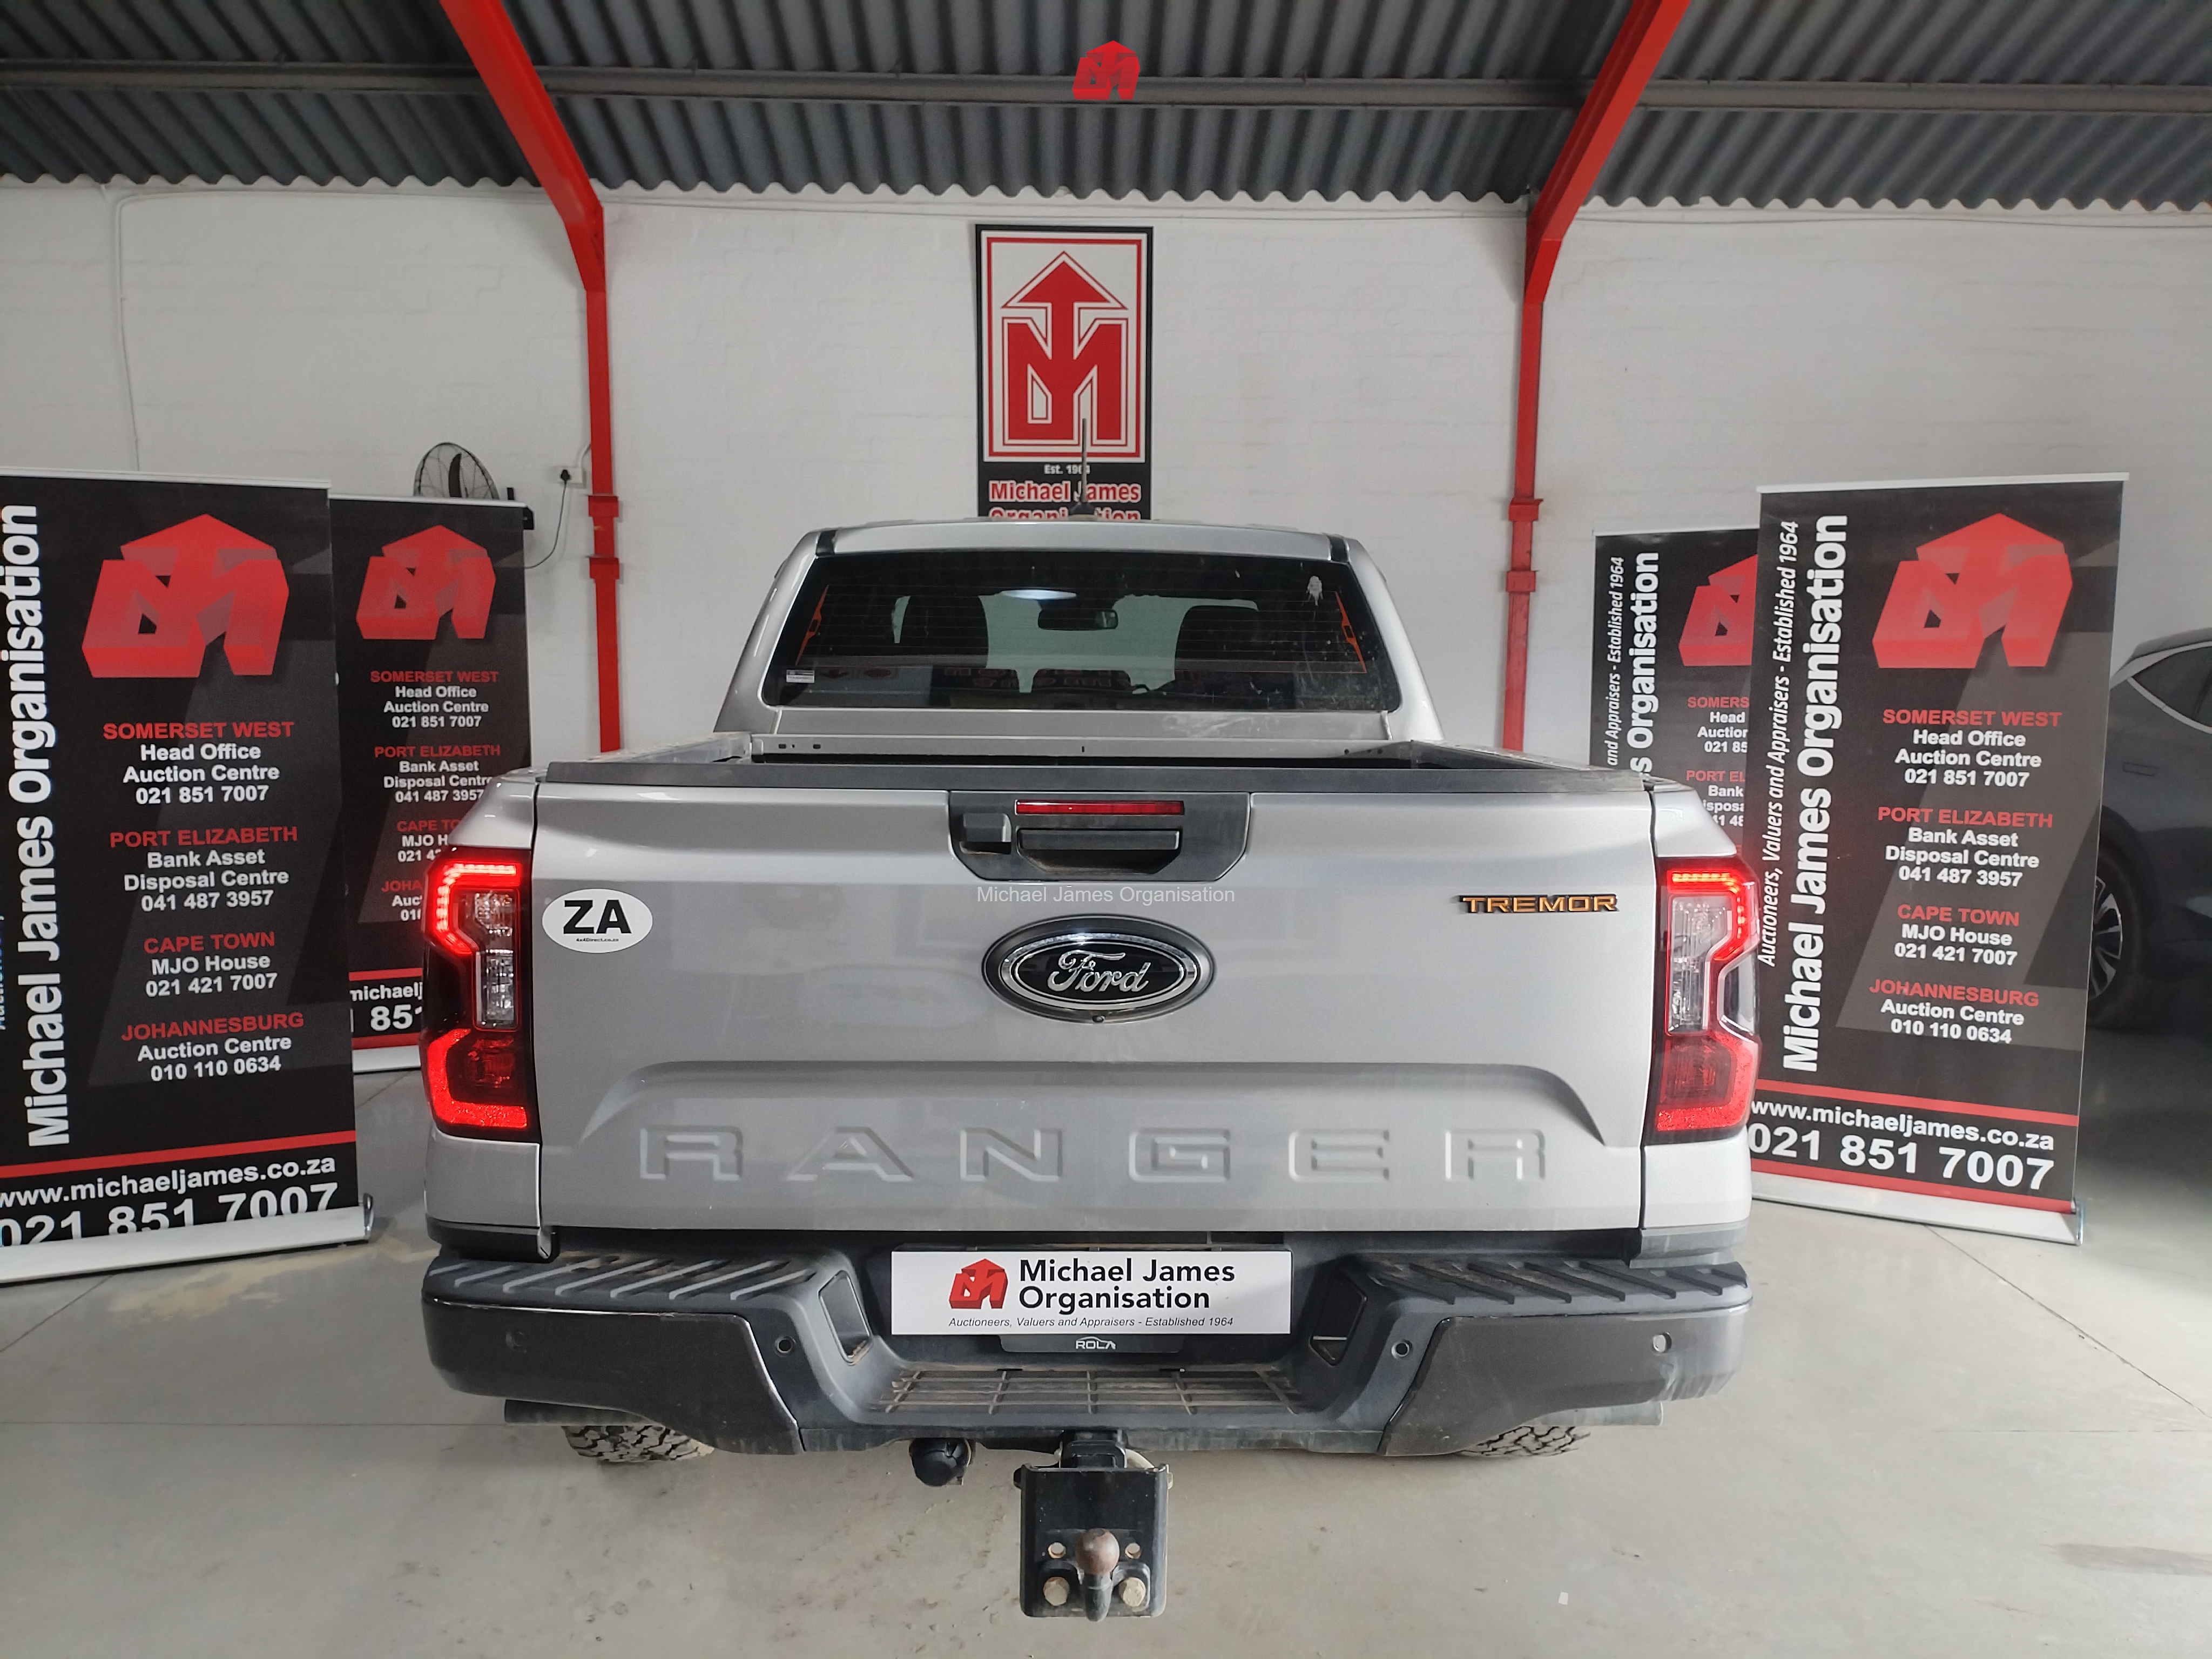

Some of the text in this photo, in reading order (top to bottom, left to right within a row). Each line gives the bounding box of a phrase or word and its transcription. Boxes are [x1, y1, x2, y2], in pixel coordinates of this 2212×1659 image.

[1044, 464, 1063, 474] Est.
[989, 480, 1071, 502] Michael
[1779, 522, 1798, 562] 1964
[1610, 557, 1624, 588] 1964
[1773, 567, 1795, 662] Established
[1607, 591, 1622, 663] Established
[1627, 553, 1658, 748] Organisation
[371, 671, 498, 682] SOMERSET WEST
[395, 686, 476, 697] Head Office
[1688, 696, 1750, 708] SOMERS
[384, 701, 488, 712] Auction Centre
[1604, 673, 1622, 746] Appraisers
[392, 716, 481, 727] 021 851 7007
[1710, 712, 1745, 723] Head
[1768, 676, 1790, 763] Appraisers
[1883, 709, 2061, 726] SOMERSET WEST
[104, 721, 294, 739] SOMERSET WEST
[1913, 729, 2026, 746] Head Office
[141, 743, 261, 760] Head Office
[375, 745, 500, 758] PORT ELIZABETH
[1608, 750, 1617, 765] and
[1704, 741, 1748, 753] 021 85
[1895, 748, 2041, 767] Auction Centre
[123, 765, 280, 783] Auction Centre
[400, 760, 479, 772] Bank Asset
[1687, 770, 1725, 781] PORT
[384, 775, 445, 790] Disposal
[1766, 765, 1784, 798] and
[1905, 768, 2029, 787] 021 851 7007
[136, 785, 269, 804] 021 851 7007
[395, 789, 484, 802] 041 487 3957
[1708, 785, 1744, 797] Bank
[1783, 516, 1847, 1071] Michael James Organisation
[0, 505, 69, 1146] Michael James Organisation
[397, 820, 437, 832] CAPE
[1878, 807, 2053, 827] PORT ELIZABETH
[110, 827, 297, 847] PORT ELIZABETH
[402, 835, 434, 847] MJO
[1762, 802, 1782, 860] Valuers
[1908, 827, 2018, 847] Bank Asset
[147, 849, 265, 868] Bank Asset
[398, 850, 421, 862] 021
[1886, 846, 2039, 868] Disposal Centre
[124, 869, 289, 893] Disposal Centre
[1899, 866, 2022, 886] 041 487 3957
[141, 890, 273, 911] 041 487 3957
[1461, 894, 1619, 913] TREMOR
[563, 900, 632, 934] ZA
[1757, 868, 1783, 967] Auctioneers,
[1898, 905, 2019, 926] CAPE TOWN
[144, 932, 274, 953] CAPE TOWN
[1902, 923, 2012, 946] MJO House
[1894, 943, 2018, 965] 021 421 7007
[152, 955, 270, 975] MJO House
[1047, 950, 1151, 992] Ford
[146, 973, 277, 996] 021 421 7007
[1870, 979, 2039, 1006] JOHANNESBURG
[1881, 999, 2024, 1025] Auction Centre
[122, 1013, 304, 1041] JOHANNESBURG
[1891, 1019, 2012, 1044] 010 110 0634
[138, 1036, 291, 1061] Auction Centre
[151, 1055, 281, 1081] 010 110 0634
[1751, 1100, 2054, 1151] www.michaeljames.co.za
[639, 1125, 1546, 1183] RANGER
[1749, 1123, 2054, 1190] 021 851 7007
[0, 1157, 335, 1208] www.michaeljames.co.za
[109, 1198, 195, 1235] 851
[218, 1182, 338, 1222] 7007
[1021, 1258, 1235, 1281] Michael James
[1020, 1286, 1209, 1315] Organisation
[949, 1318, 1011, 1327] Auctioneers,
[1017, 1318, 1054, 1326] Valuers
[1058, 1318, 1077, 1326] and
[1080, 1318, 1135, 1328] Appraisers
[1145, 1318, 1205, 1326] Established
[1210, 1318, 1233, 1326] 1964
[1075, 1337, 1116, 1350] ROLA
